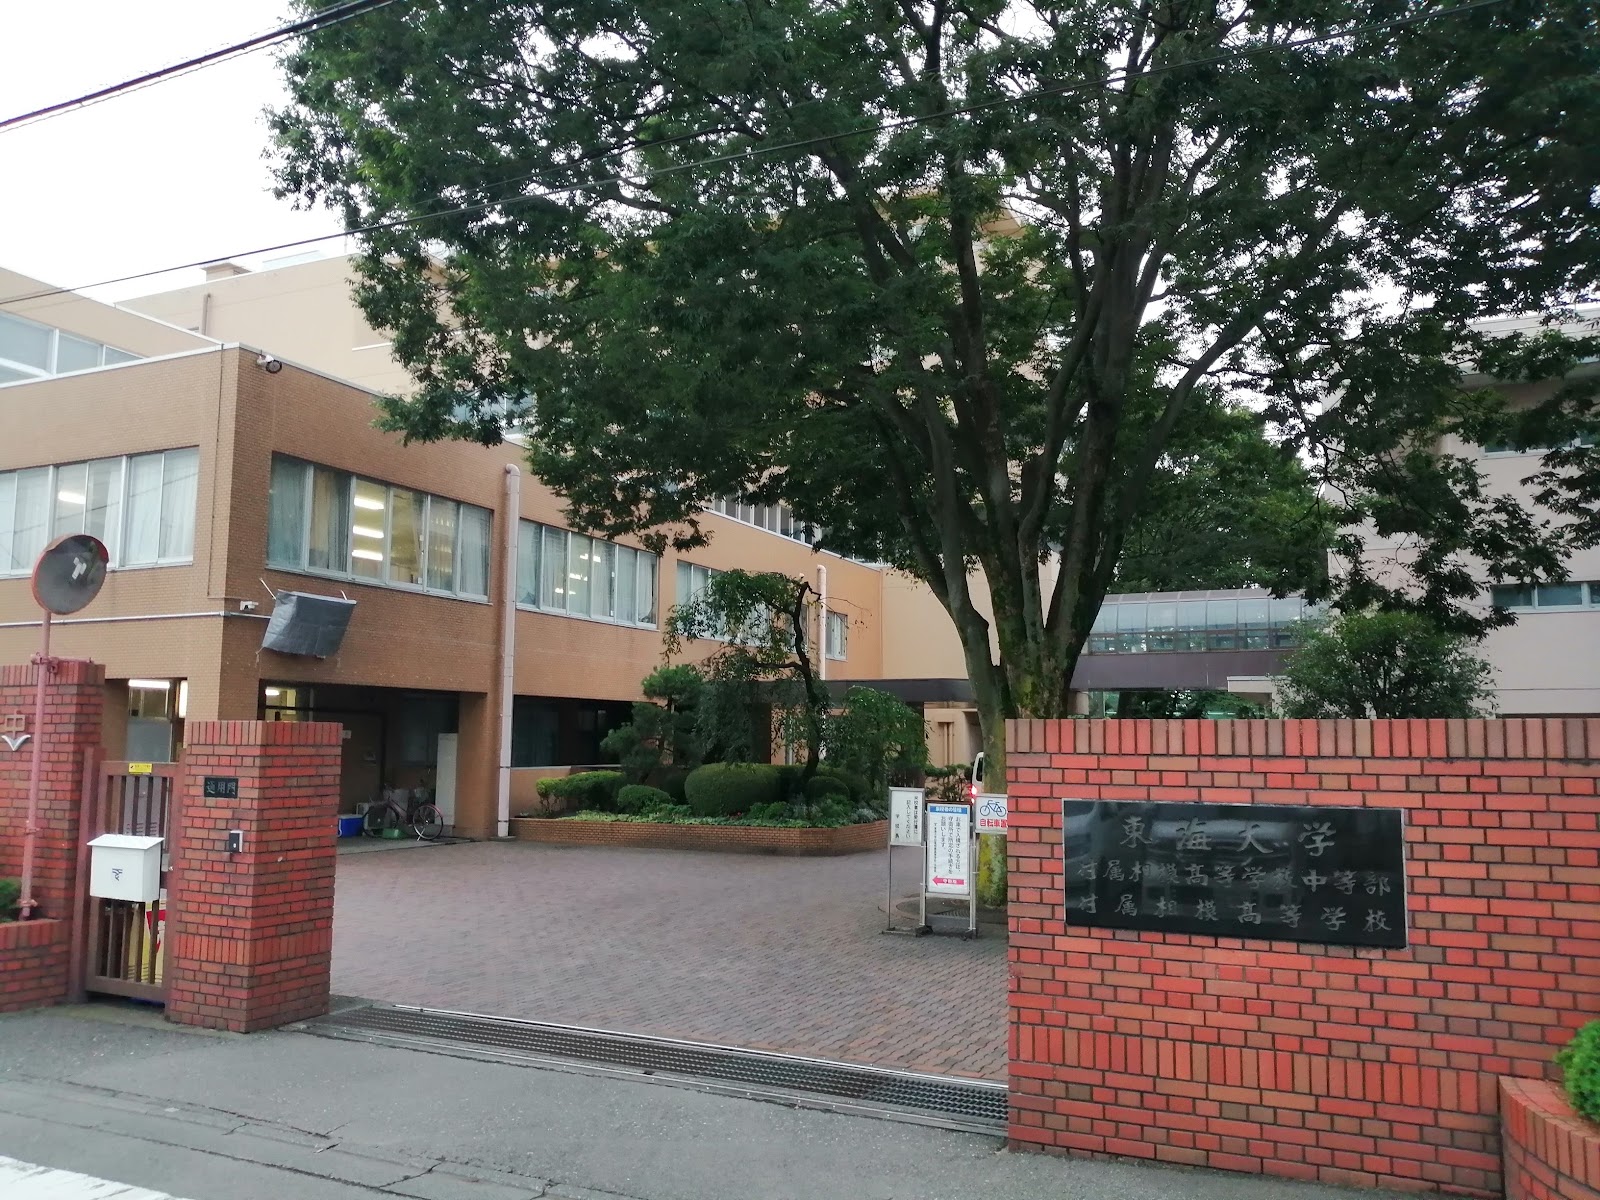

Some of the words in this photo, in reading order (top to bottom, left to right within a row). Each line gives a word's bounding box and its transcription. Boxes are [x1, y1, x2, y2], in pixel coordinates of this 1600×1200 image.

[205, 780, 236, 796] 通用門
[1119, 815, 1337, 858] 東海大学
[1077, 859, 1392, 897] 付属相模高等学校中等部
[1077, 892, 1393, 933] 付属相模高等学校
